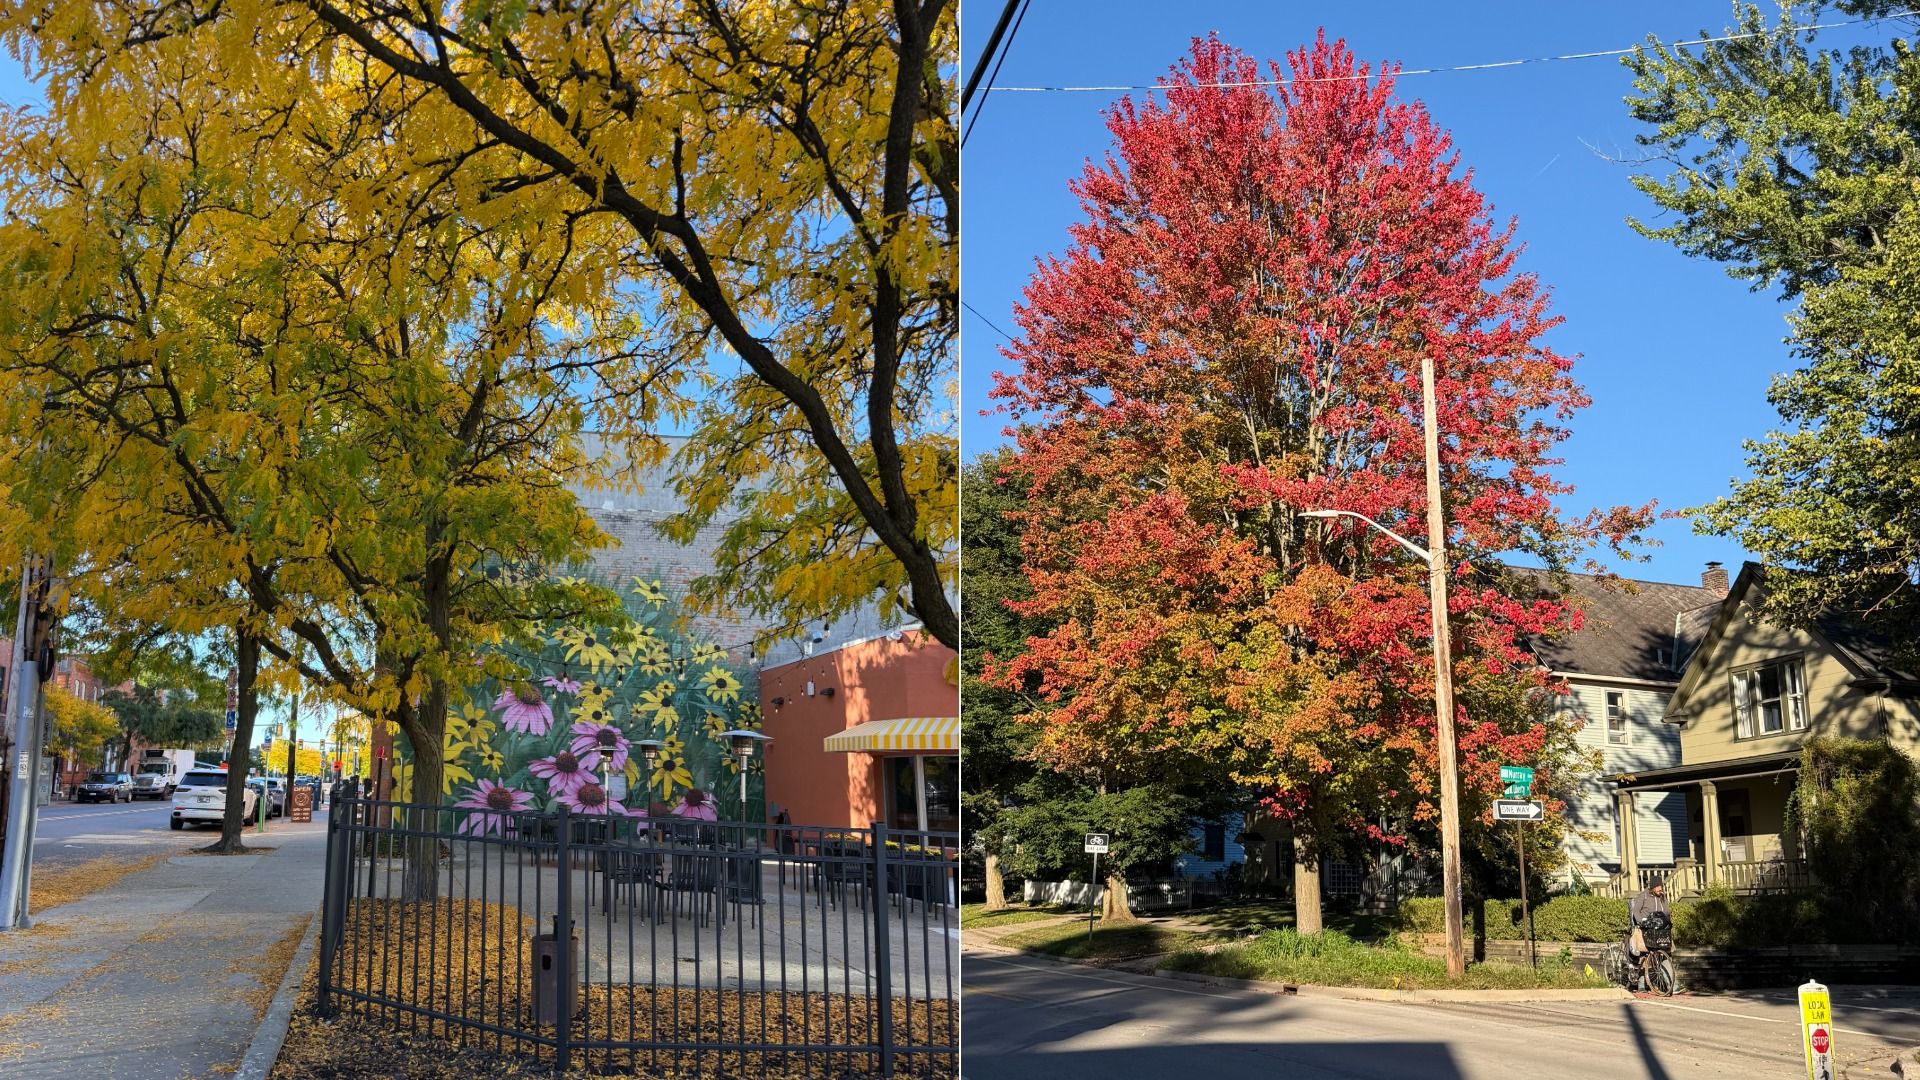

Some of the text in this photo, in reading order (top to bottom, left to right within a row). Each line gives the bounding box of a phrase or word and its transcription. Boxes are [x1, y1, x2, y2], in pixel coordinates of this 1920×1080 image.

[1501, 805, 1530, 813] ONE WAY
[1812, 1011, 1825, 1020] LAW
[1813, 1036, 1829, 1047] STOP
